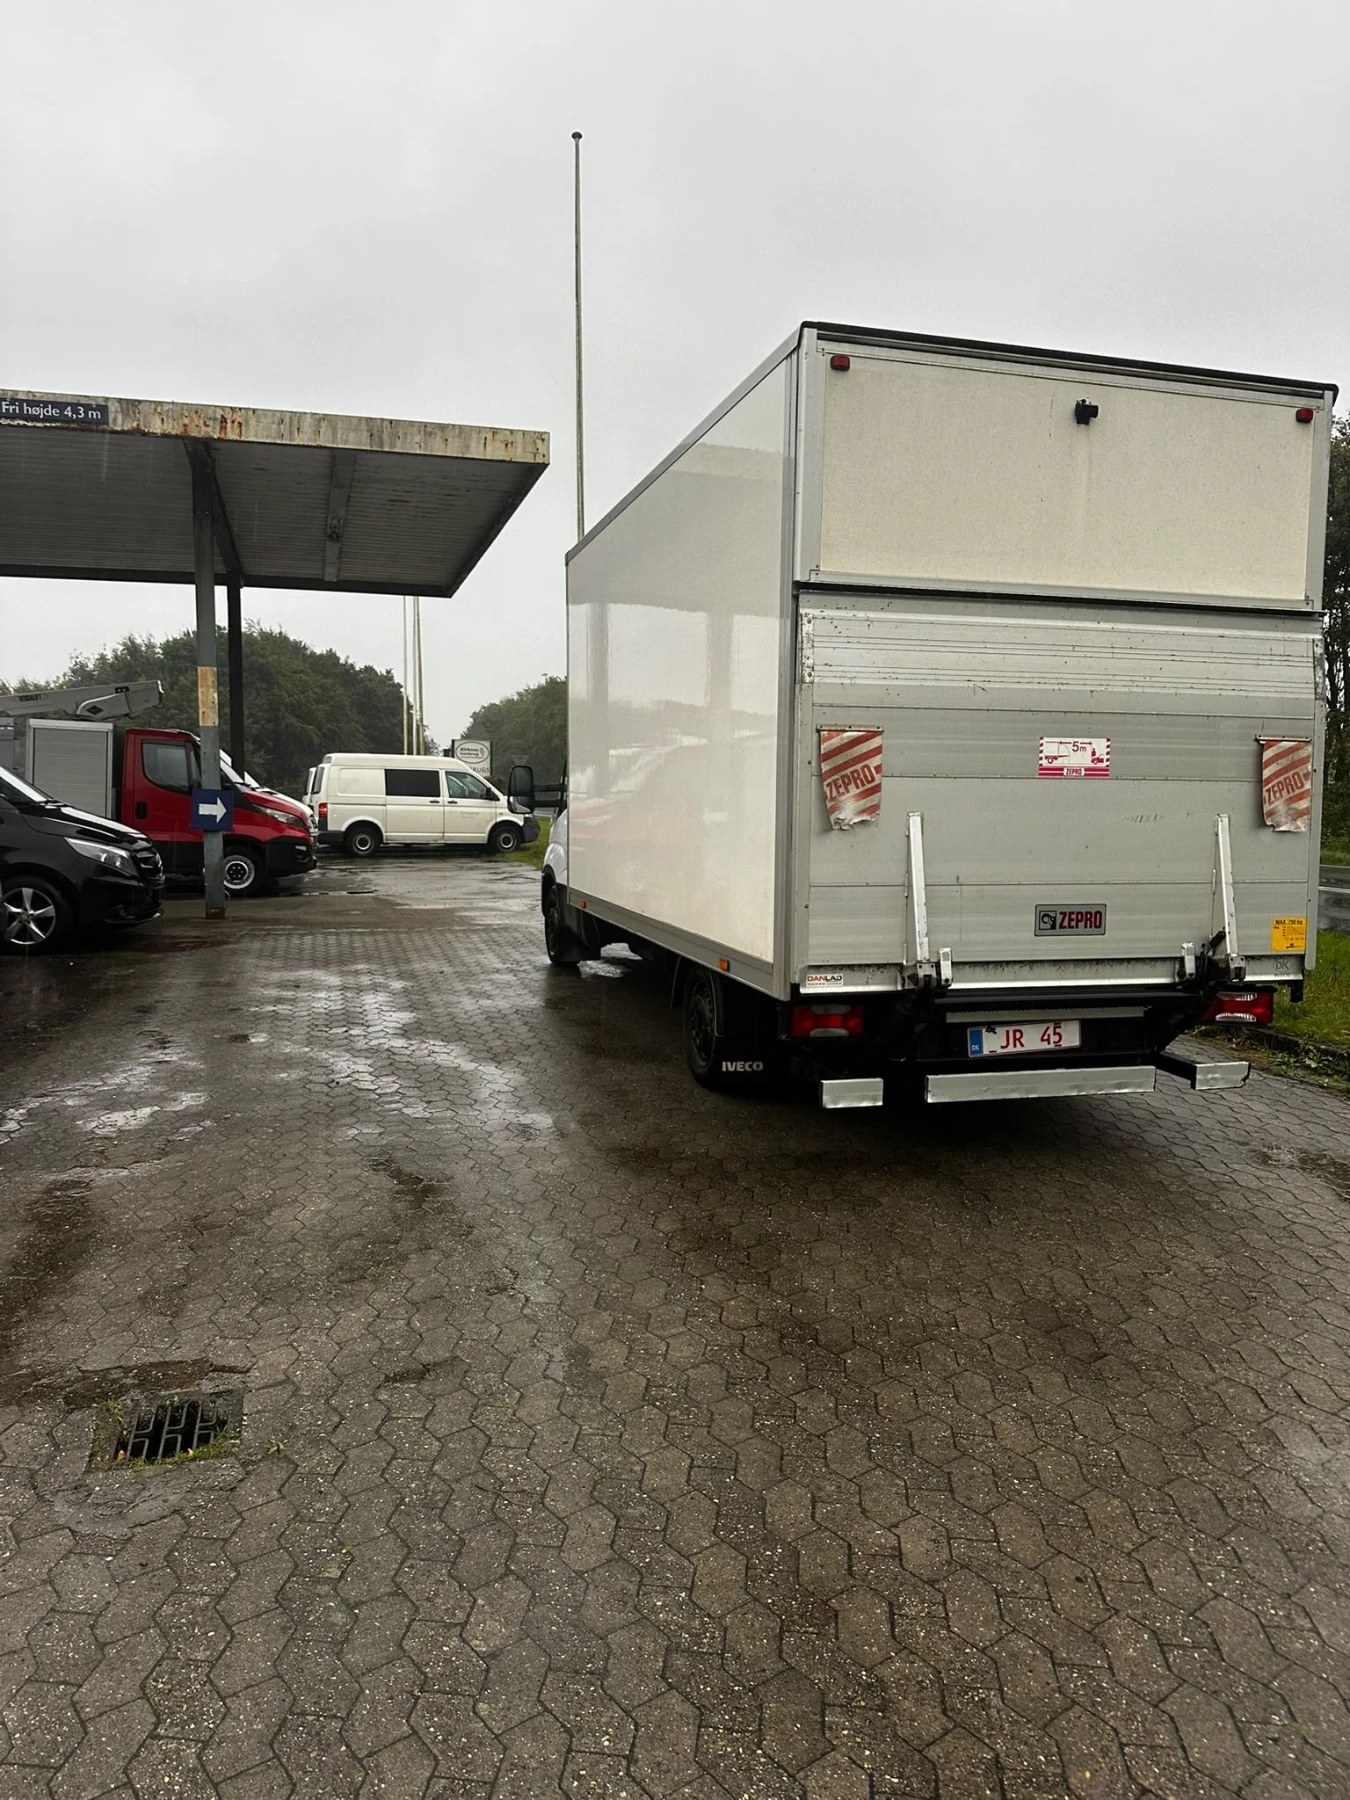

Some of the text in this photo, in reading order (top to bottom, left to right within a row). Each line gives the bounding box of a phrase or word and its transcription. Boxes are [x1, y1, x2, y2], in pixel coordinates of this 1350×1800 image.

[2, 401, 101, 419] Fri højde 4,3 m
[826, 763, 876, 801] ZEPRO
[1265, 771, 1305, 807] ZEPRO
[1059, 910, 1103, 929] ZEPRO
[1275, 960, 1289, 970] DK
[1000, 1025, 1063, 1049] JR 45
[721, 1061, 764, 1072] IVECO
